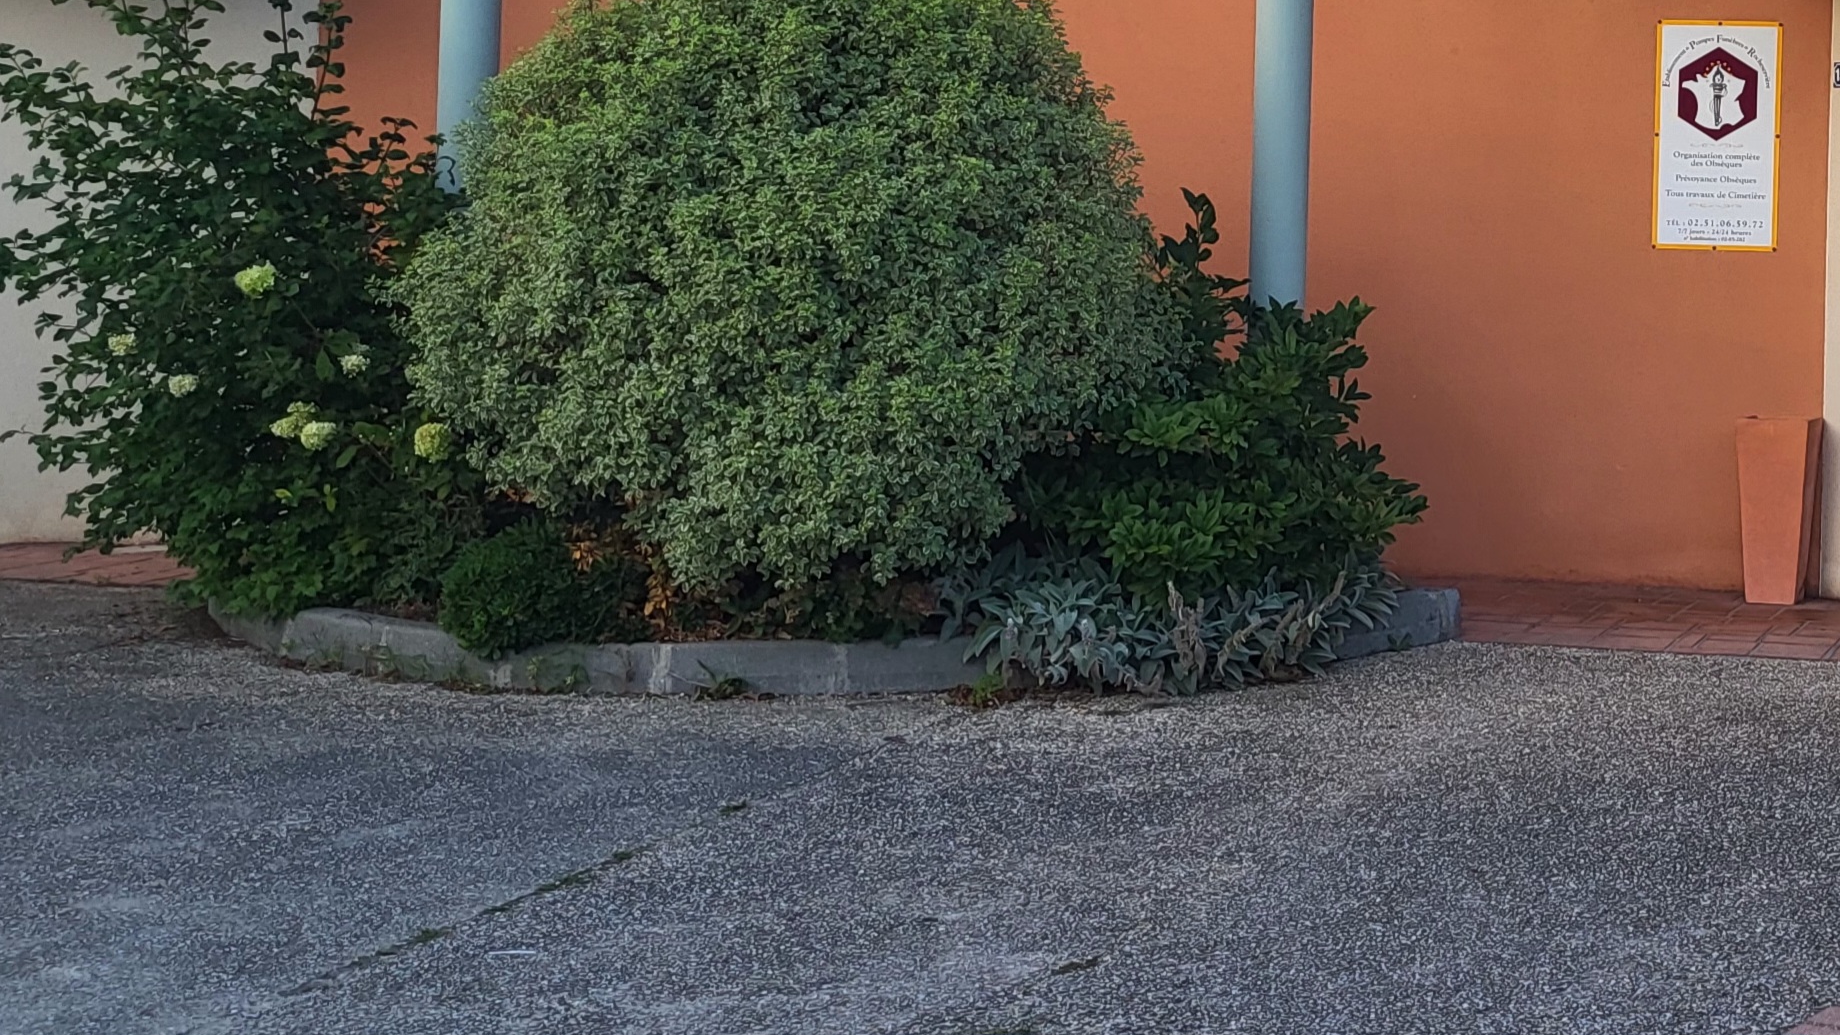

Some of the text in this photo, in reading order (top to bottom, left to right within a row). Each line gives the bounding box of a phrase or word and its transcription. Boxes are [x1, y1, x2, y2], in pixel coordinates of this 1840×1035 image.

[1673, 150, 1760, 162] Organisation complète
[1691, 159, 1703, 167] des
[1675, 174, 1718, 184] Prévoyance
[1665, 188, 1767, 201] Tous travaux de Cimetière
